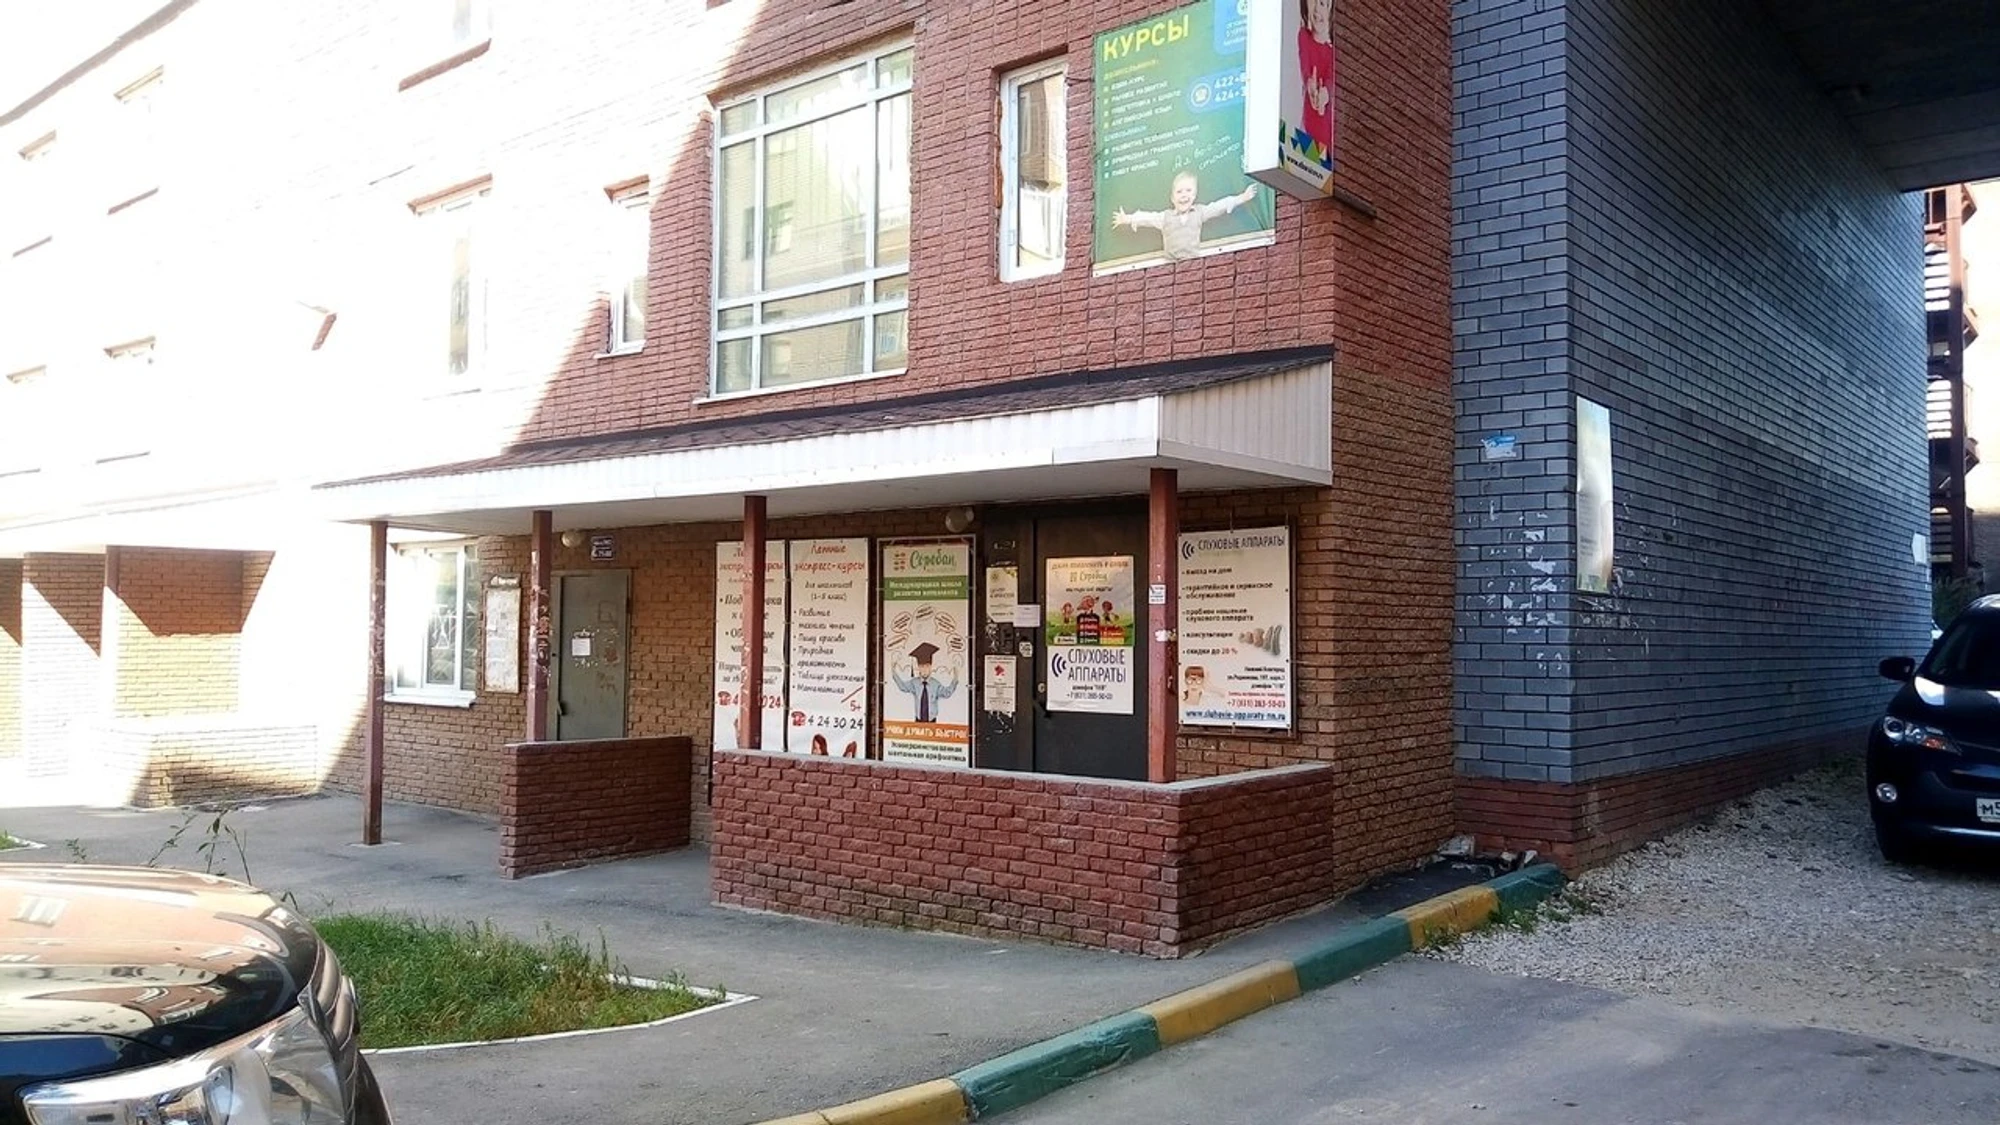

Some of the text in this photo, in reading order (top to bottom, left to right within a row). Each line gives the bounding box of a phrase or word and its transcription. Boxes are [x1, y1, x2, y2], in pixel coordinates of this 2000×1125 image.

[1103, 14, 1189, 61] КУРСЫ
[1198, 535, 1286, 550] СЛУХОВЫЕ АППАРАТЫ
[1067, 649, 1125, 665] СЛУХОВЫЕ
[1067, 666, 1126, 683] АППАРАТЫ
[817, 715, 830, 727] 24
[832, 717, 847, 729] 30
[849, 718, 864, 730] 24
